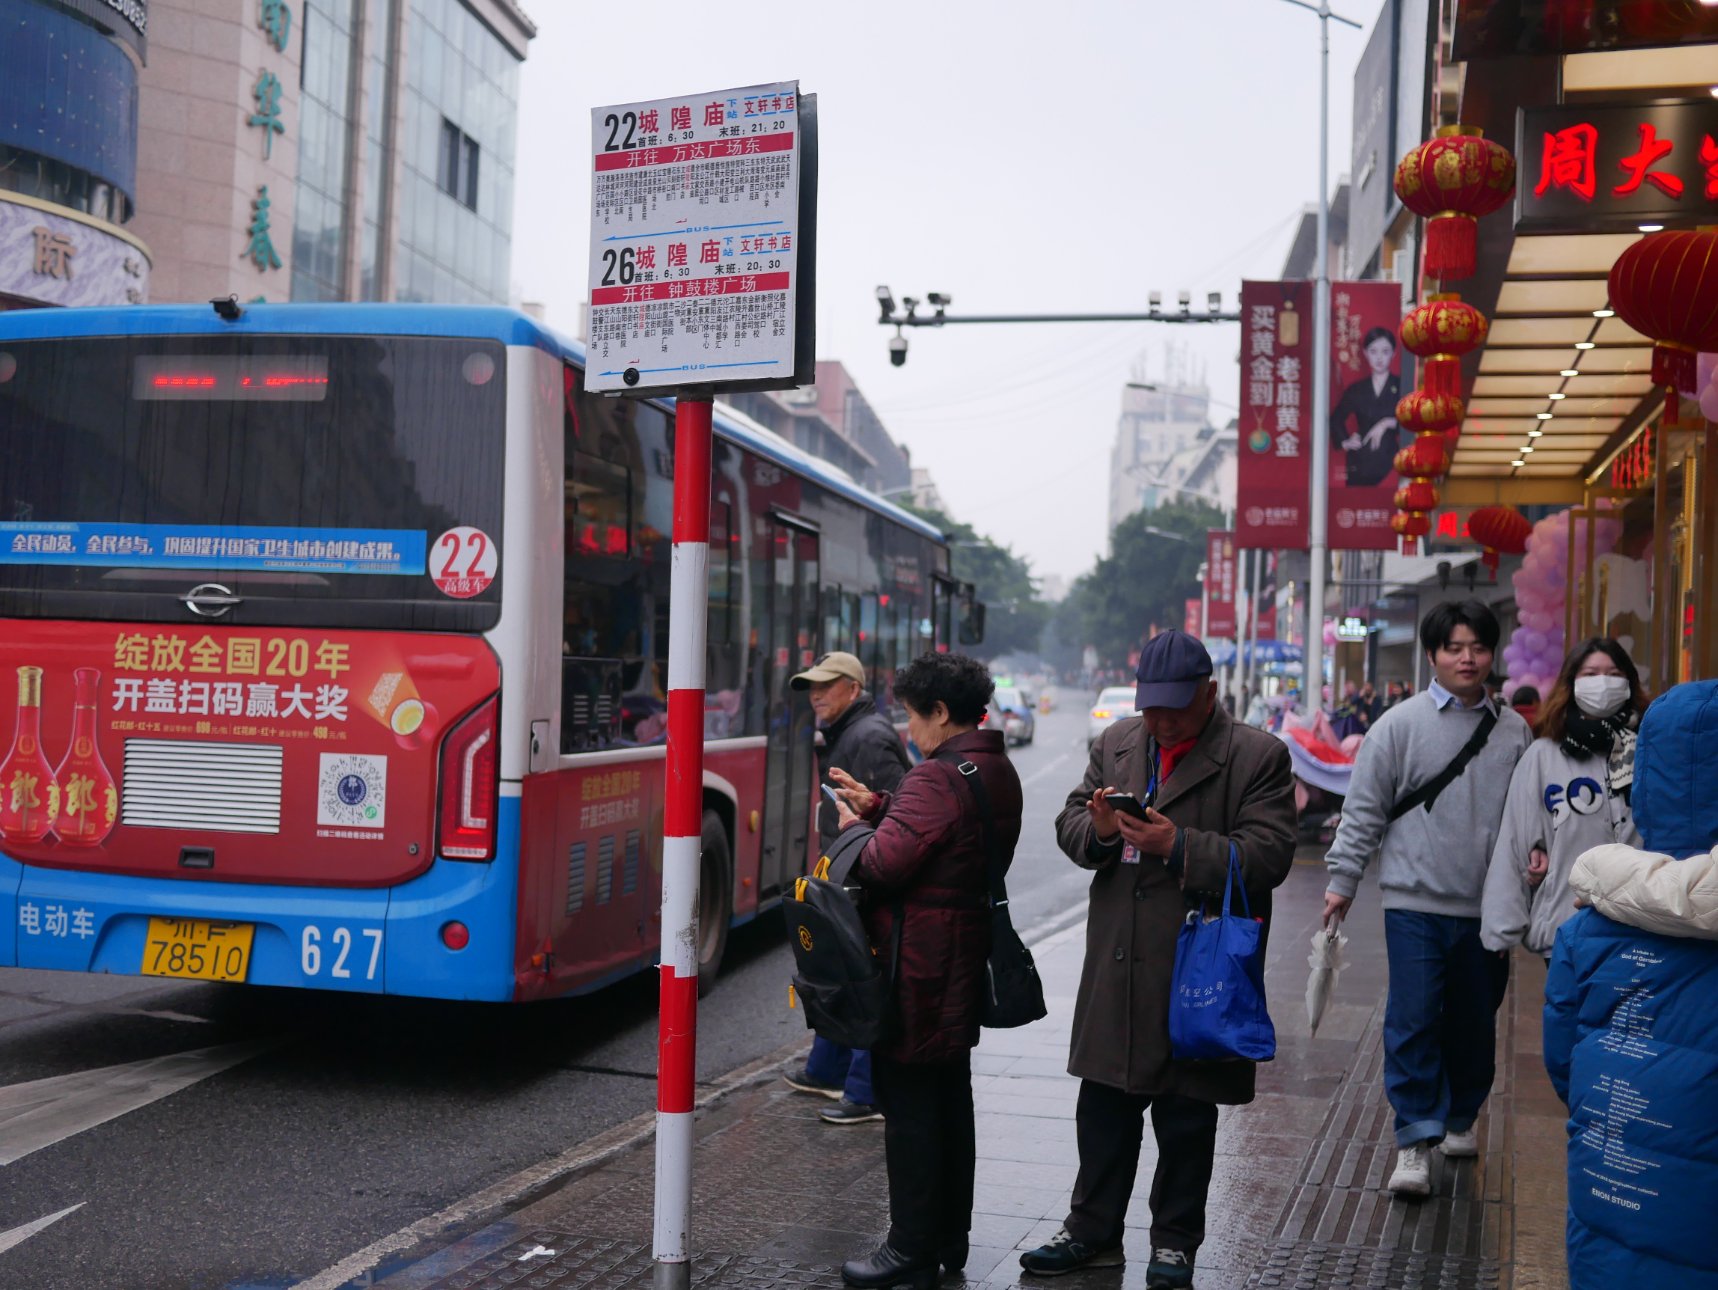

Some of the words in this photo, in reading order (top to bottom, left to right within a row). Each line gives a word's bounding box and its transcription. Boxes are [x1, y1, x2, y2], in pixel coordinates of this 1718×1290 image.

[638, 101, 725, 134] 城隍庙
[726, 98, 738, 119] 下站
[744, 96, 795, 114] 文轩书店
[604, 111, 638, 151] 22
[626, 151, 658, 168] 开往
[672, 138, 761, 163] 万达广场东
[686, 225, 710, 234] BUS
[722, 236, 734, 256] 下站
[741, 236, 791, 252] 文轩书店
[33, 226, 79, 280] 际
[601, 247, 635, 286] 26
[634, 239, 720, 270] 城隍庙
[622, 285, 655, 302] 开往
[668, 275, 757, 298] 钟鼓楼广场
[682, 362, 705, 371] BUS
[1250, 305, 1276, 406] 买黄金到
[1276, 355, 1300, 457] 老庙黄金
[441, 532, 488, 578] 22
[113, 632, 350, 679] 绽放全国20年
[111, 677, 349, 721] 开盖扫码赢大奖
[10, 770, 41, 833] 郎
[66, 773, 98, 835] 郎
[19, 903, 95, 940] 电动车
[151, 940, 243, 977] 78510
[301, 926, 383, 980] 627
[1611, 1194, 1641, 1211] STUDIO
